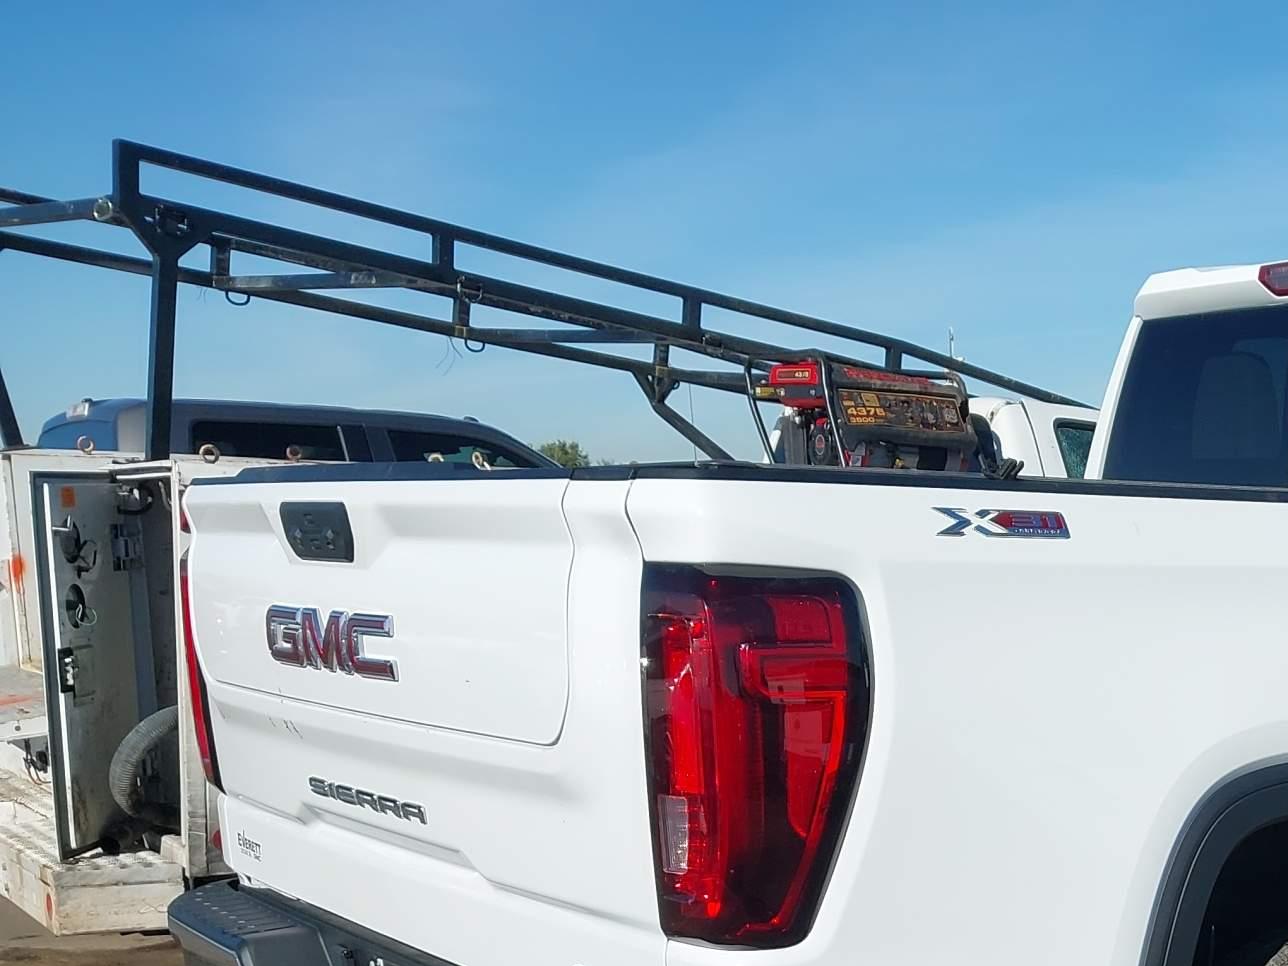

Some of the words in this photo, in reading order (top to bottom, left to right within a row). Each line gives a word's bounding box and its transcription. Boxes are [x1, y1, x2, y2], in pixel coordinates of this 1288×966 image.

[266, 604, 399, 682] GMC
[309, 776, 428, 825] SIERRA
[237, 830, 261, 856] EVERETT
